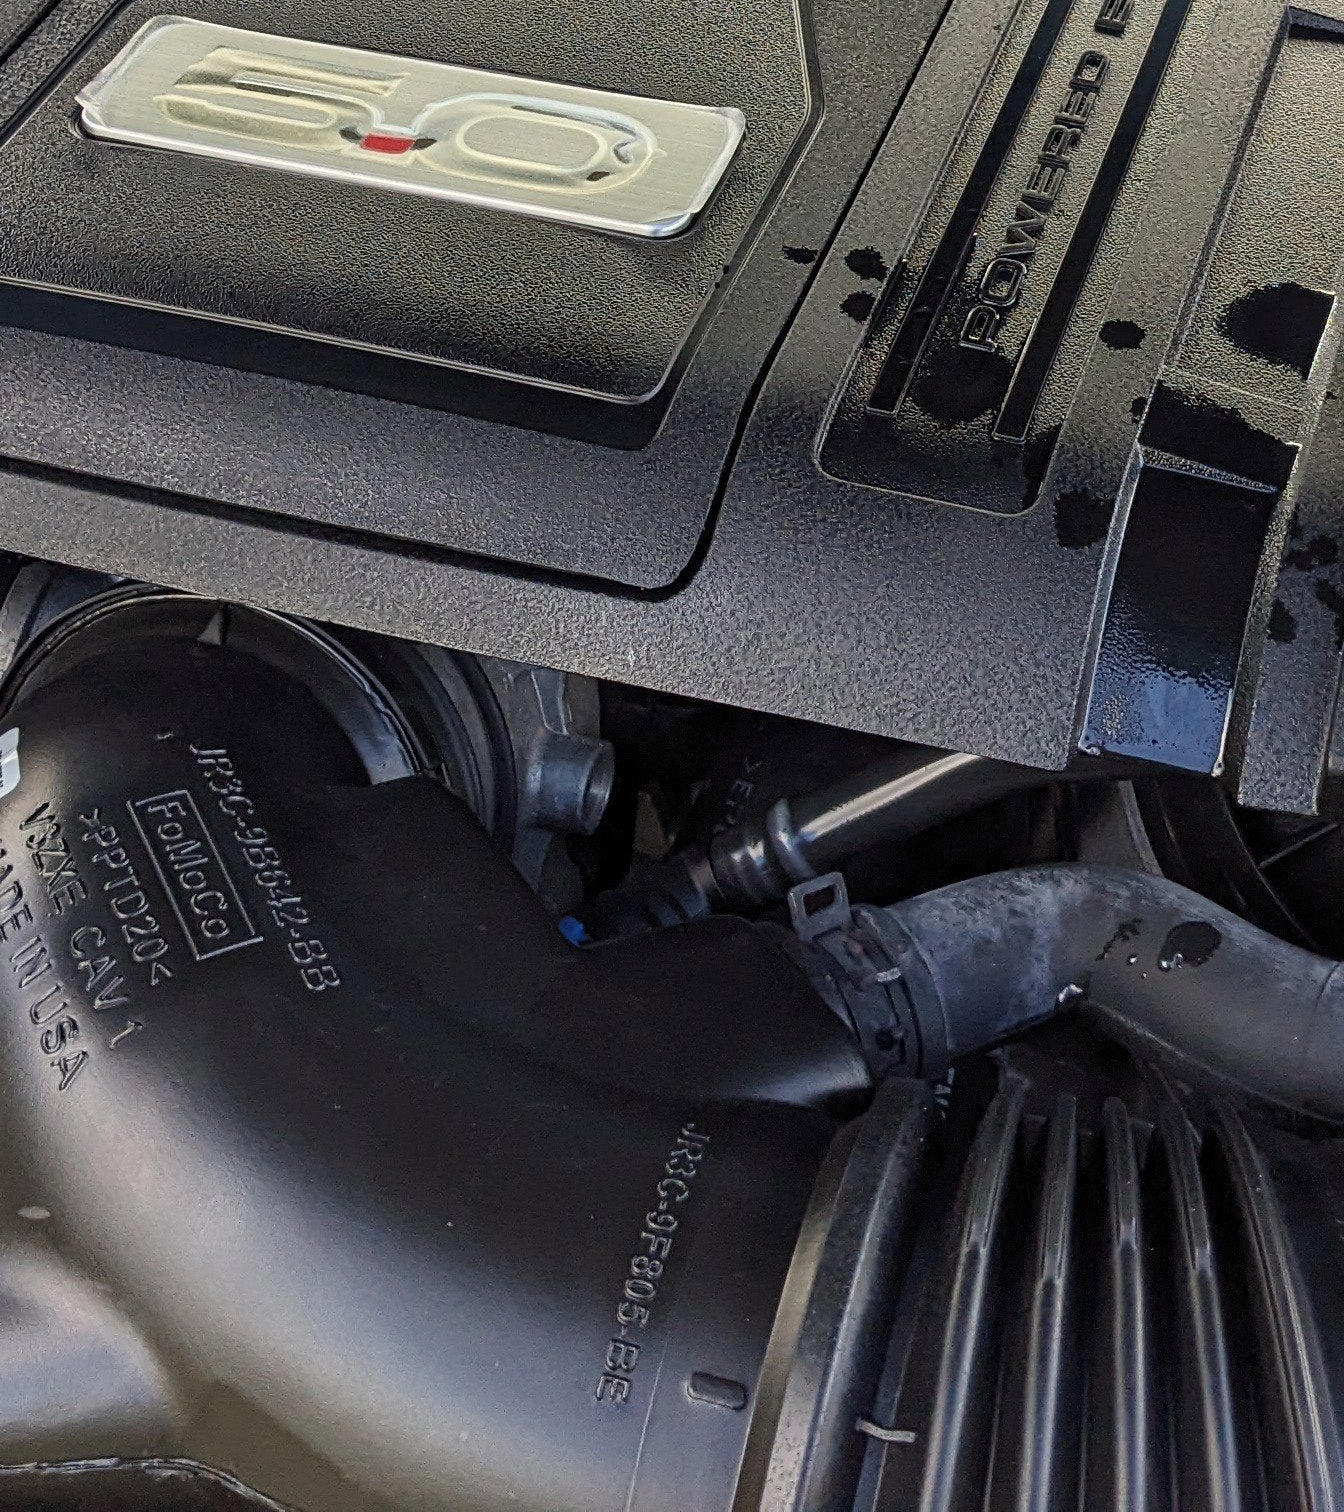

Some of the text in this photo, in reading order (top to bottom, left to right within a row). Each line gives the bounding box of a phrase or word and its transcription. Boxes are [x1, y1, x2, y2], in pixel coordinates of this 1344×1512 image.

[156, 45, 659, 195] 5.0
[960, 49, 1111, 353] POWERED
[149, 797, 231, 940] FoMoCo
[190, 742, 341, 992] JR3C-9B642-BB
[10, 934, 55, 990] IN
[70, 925, 130, 1010] CAV
[30, 989, 89, 1091] USA
